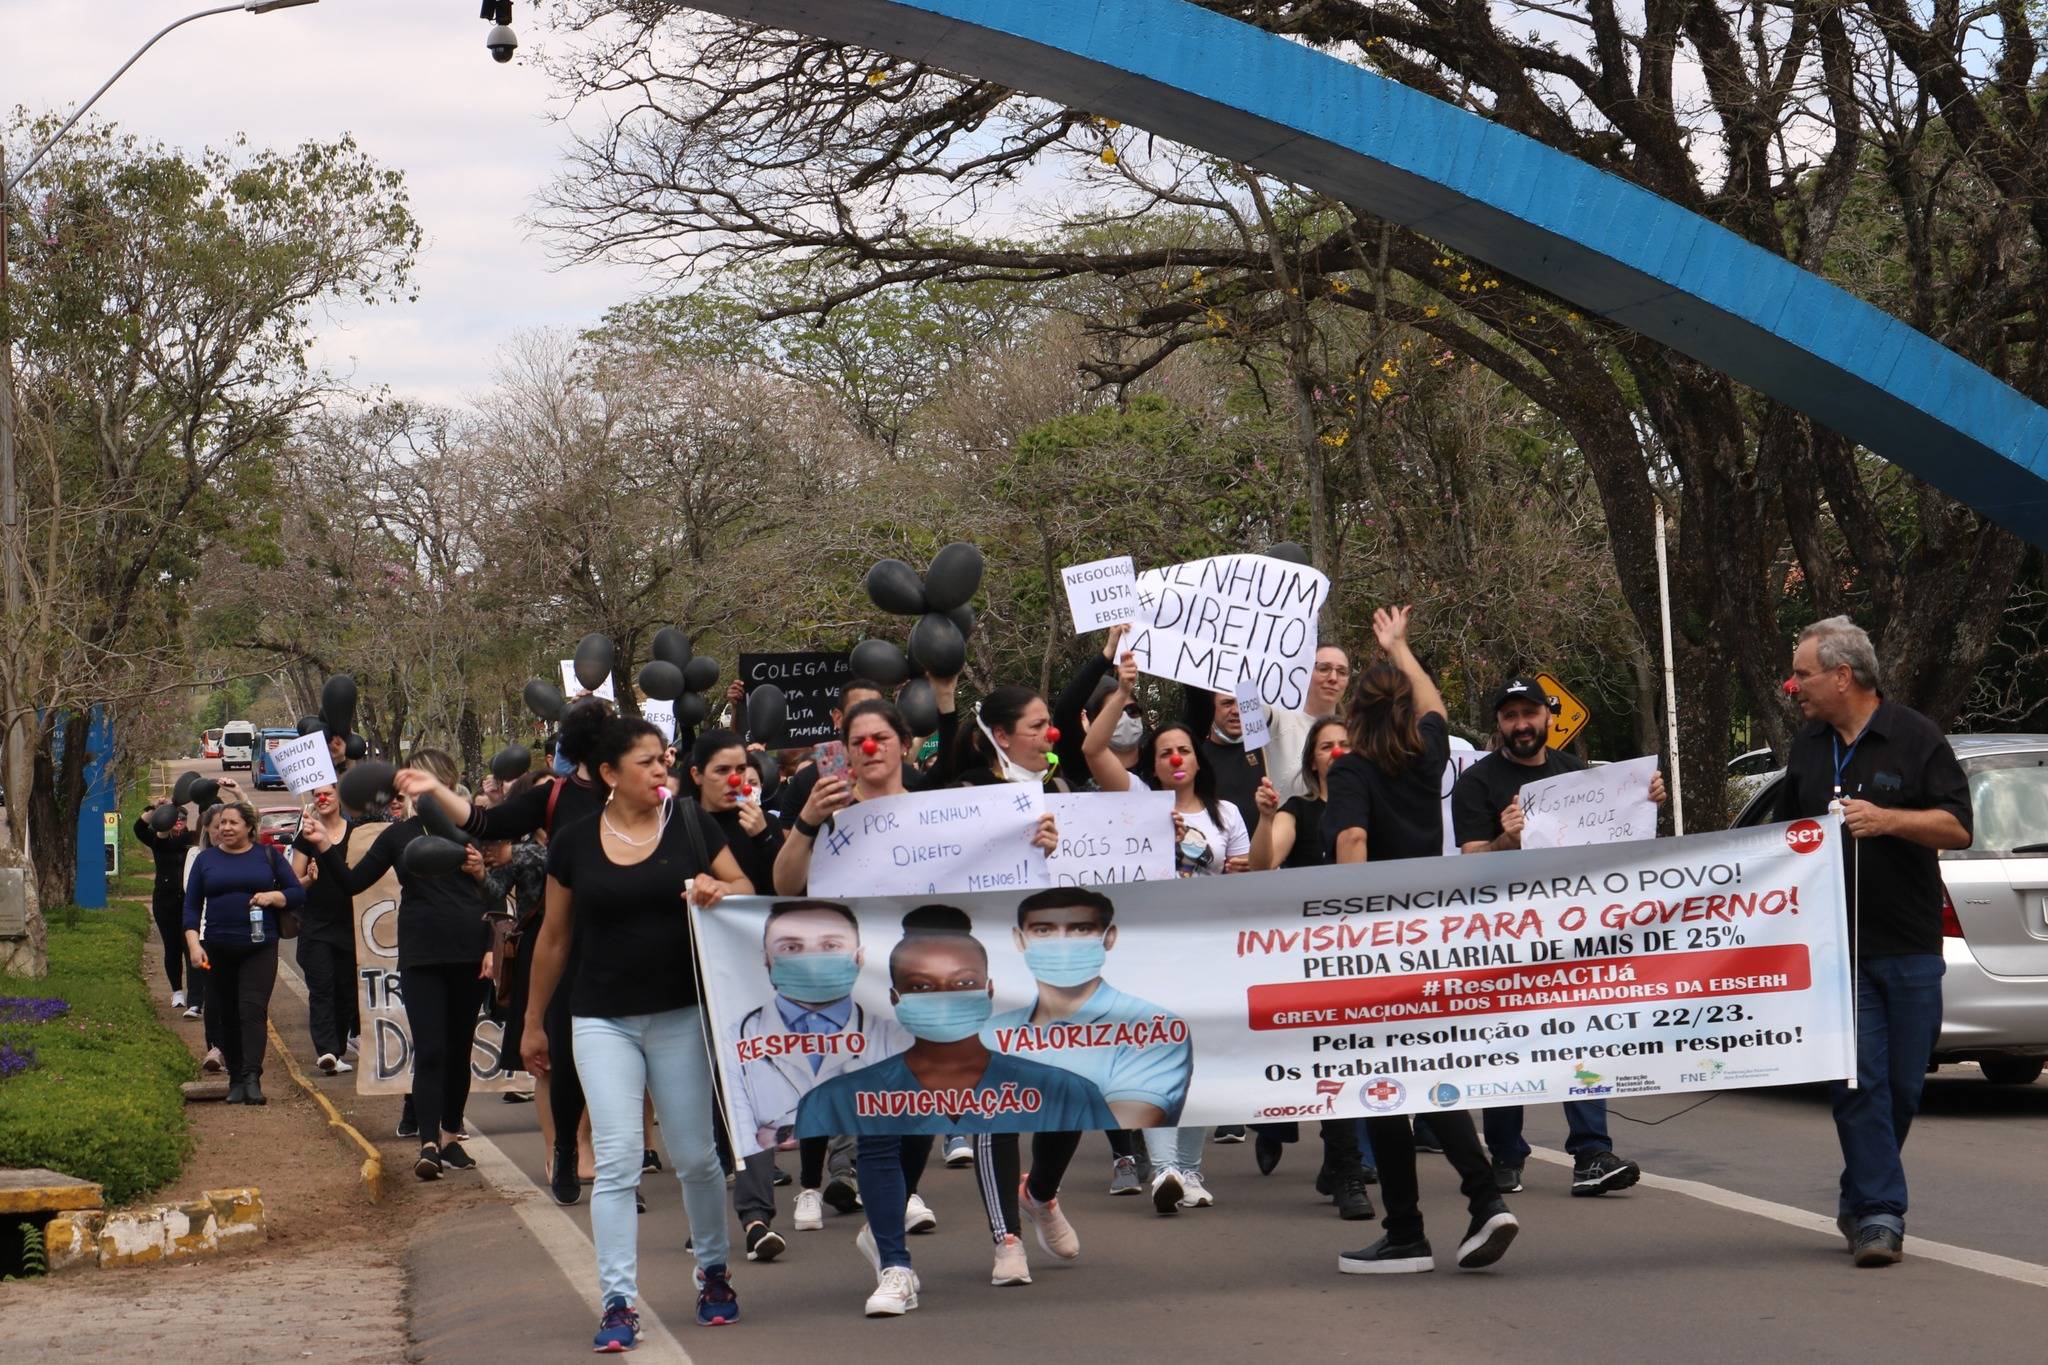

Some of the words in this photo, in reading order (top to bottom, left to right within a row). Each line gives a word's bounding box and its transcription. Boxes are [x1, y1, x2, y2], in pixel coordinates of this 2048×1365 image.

[1090, 585, 1132, 605] JUSTA
[1095, 607, 1136, 624] EBSERH
[1130, 629, 1152, 669] A
[751, 661, 828, 681] COLEGA
[834, 662, 853, 674] EB
[1174, 640, 1308, 711] MENOS
[825, 686, 841, 698] VE
[786, 705, 815, 721] LUTA
[274, 739, 316, 763] NENHUM
[863, 812, 900, 836] POR
[919, 804, 982, 827] NENHUM
[1578, 809, 1617, 830] AQUI
[1609, 823, 1634, 841] POR
[1786, 828, 1823, 845] ser
[892, 843, 963, 868] DIREITO
[1124, 837, 1153, 856] DA
[1059, 865, 1148, 888] DEMIA
[1302, 885, 1499, 918] ESSENCIAIS
[1508, 875, 1597, 901] PARA
[1603, 872, 1629, 893] O
[1638, 862, 1742, 892] POVO!
[1237, 915, 1429, 957] INVISÍVEIS
[1440, 908, 1544, 944] PARA
[1558, 906, 1588, 931] O
[1600, 886, 1800, 931] GOVERNO!
[1303, 953, 1391, 978] PERDA
[1399, 942, 1523, 973] SALARIAL
[1531, 939, 1566, 962] DE
[1574, 934, 1634, 958] MAIS
[1643, 930, 1677, 952] DE
[1687, 924, 1746, 949] 25%
[1422, 963, 1637, 997] #ResolveACTJá
[1272, 1008, 1338, 1025] GREVE
[1345, 1001, 1443, 1020] NACIONAL
[1450, 996, 1491, 1012] DOS
[1497, 982, 1669, 1007] TRABALHADORES
[1675, 979, 1704, 994] DA
[1709, 974, 1788, 992] EBSERH
[995, 1014, 1189, 1055] VALORIZAÇÃO
[1312, 1033, 1375, 1052] Pela
[1385, 1022, 1530, 1046] resolução
[1540, 1017, 1576, 1036] do
[1586, 1011, 1641, 1033] ACT
[1652, 1003, 1754, 1029] 22/23.
[737, 1032, 866, 1064] RESPEITO
[1264, 1064, 1302, 1082] Os
[1312, 1050, 1520, 1079] trabalhadores
[1531, 1039, 1664, 1064] merecem
[1675, 1026, 1804, 1055] respeito!
[1465, 1079, 1548, 1097] FENAM
[1569, 1085, 1613, 1095] Fenafar
[1680, 1073, 1707, 1083] FNE
[855, 1083, 1043, 1119] INDIGNAÇÃO
